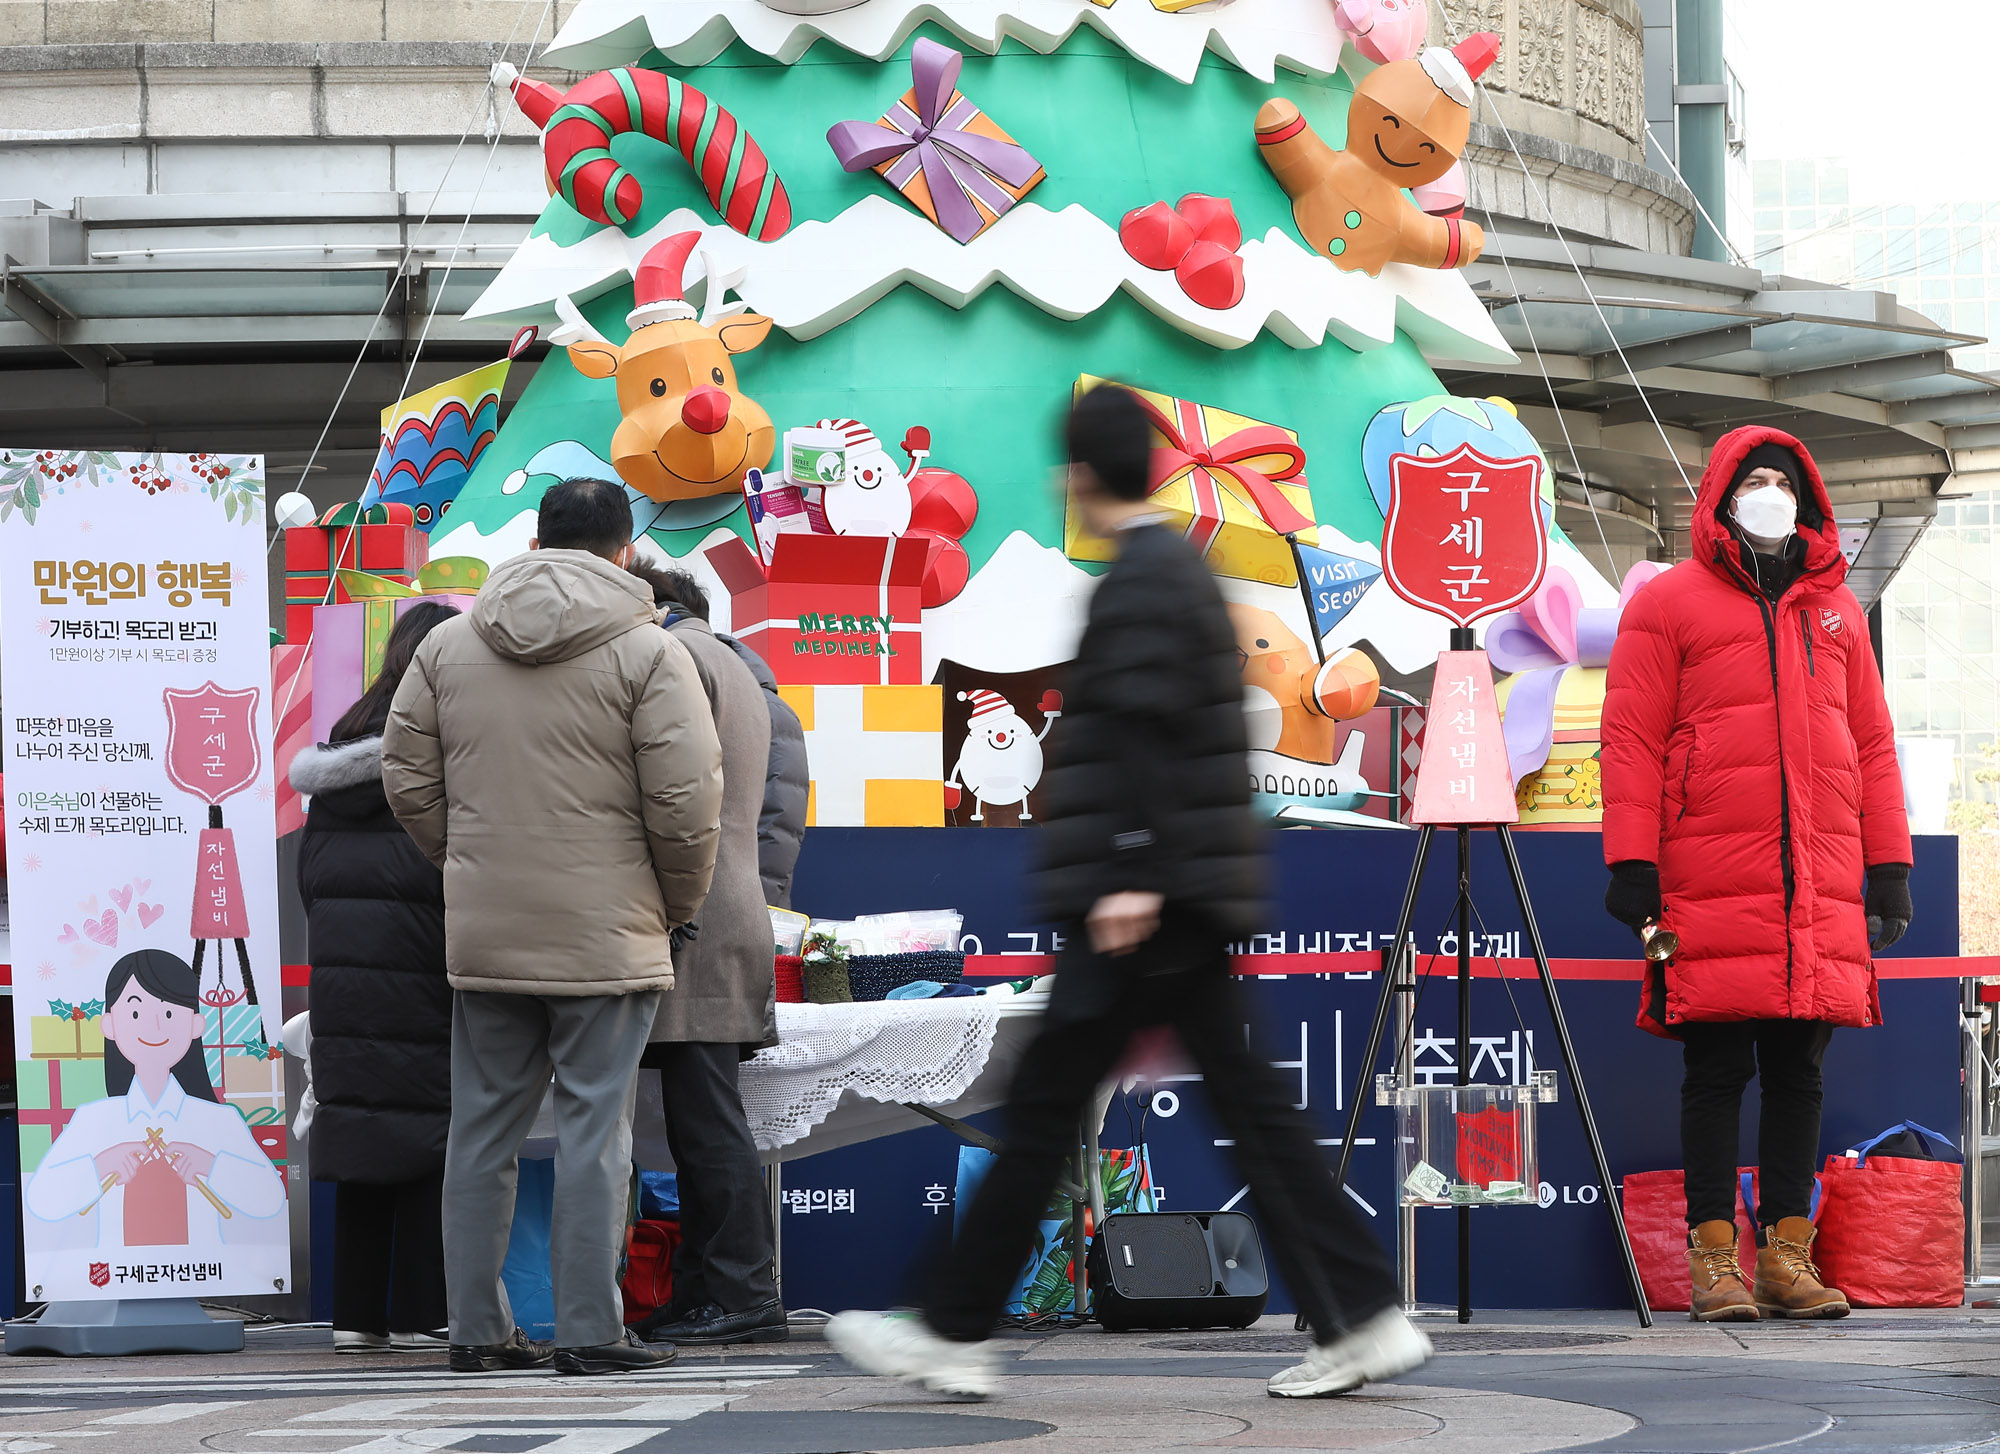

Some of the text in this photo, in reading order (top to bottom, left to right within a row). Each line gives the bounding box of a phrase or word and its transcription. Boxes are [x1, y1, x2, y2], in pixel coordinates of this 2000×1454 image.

[1439, 471, 1490, 602] 구세군
[34, 560, 232, 608] 만원의 행복
[1312, 561, 1359, 586] VISIT
[1318, 581, 1369, 614] SEOUL
[50, 620, 217, 641] 기부하고! 목도리 받고!
[798, 612, 894, 636] MERRY
[50, 647, 217, 662] 1만원이상 기부 시 목도리 증정
[793, 639, 898, 657] MEDIHEAL
[16, 718, 114, 738] 따뜻한 마음을
[1447, 676, 1480, 802] 자선냄비
[16, 742, 154, 762] 나누어 주신 당신께.
[200, 707, 226, 777] 구세군
[18, 792, 163, 811] 이은숙님이 선물하는
[18, 816, 187, 836] 수제 뜨개 목도리입니다.
[206, 842, 228, 926] 자선냄비
[922, 1183, 957, 1215] 후
[115, 1263, 222, 1283] 구세군자선냄비
